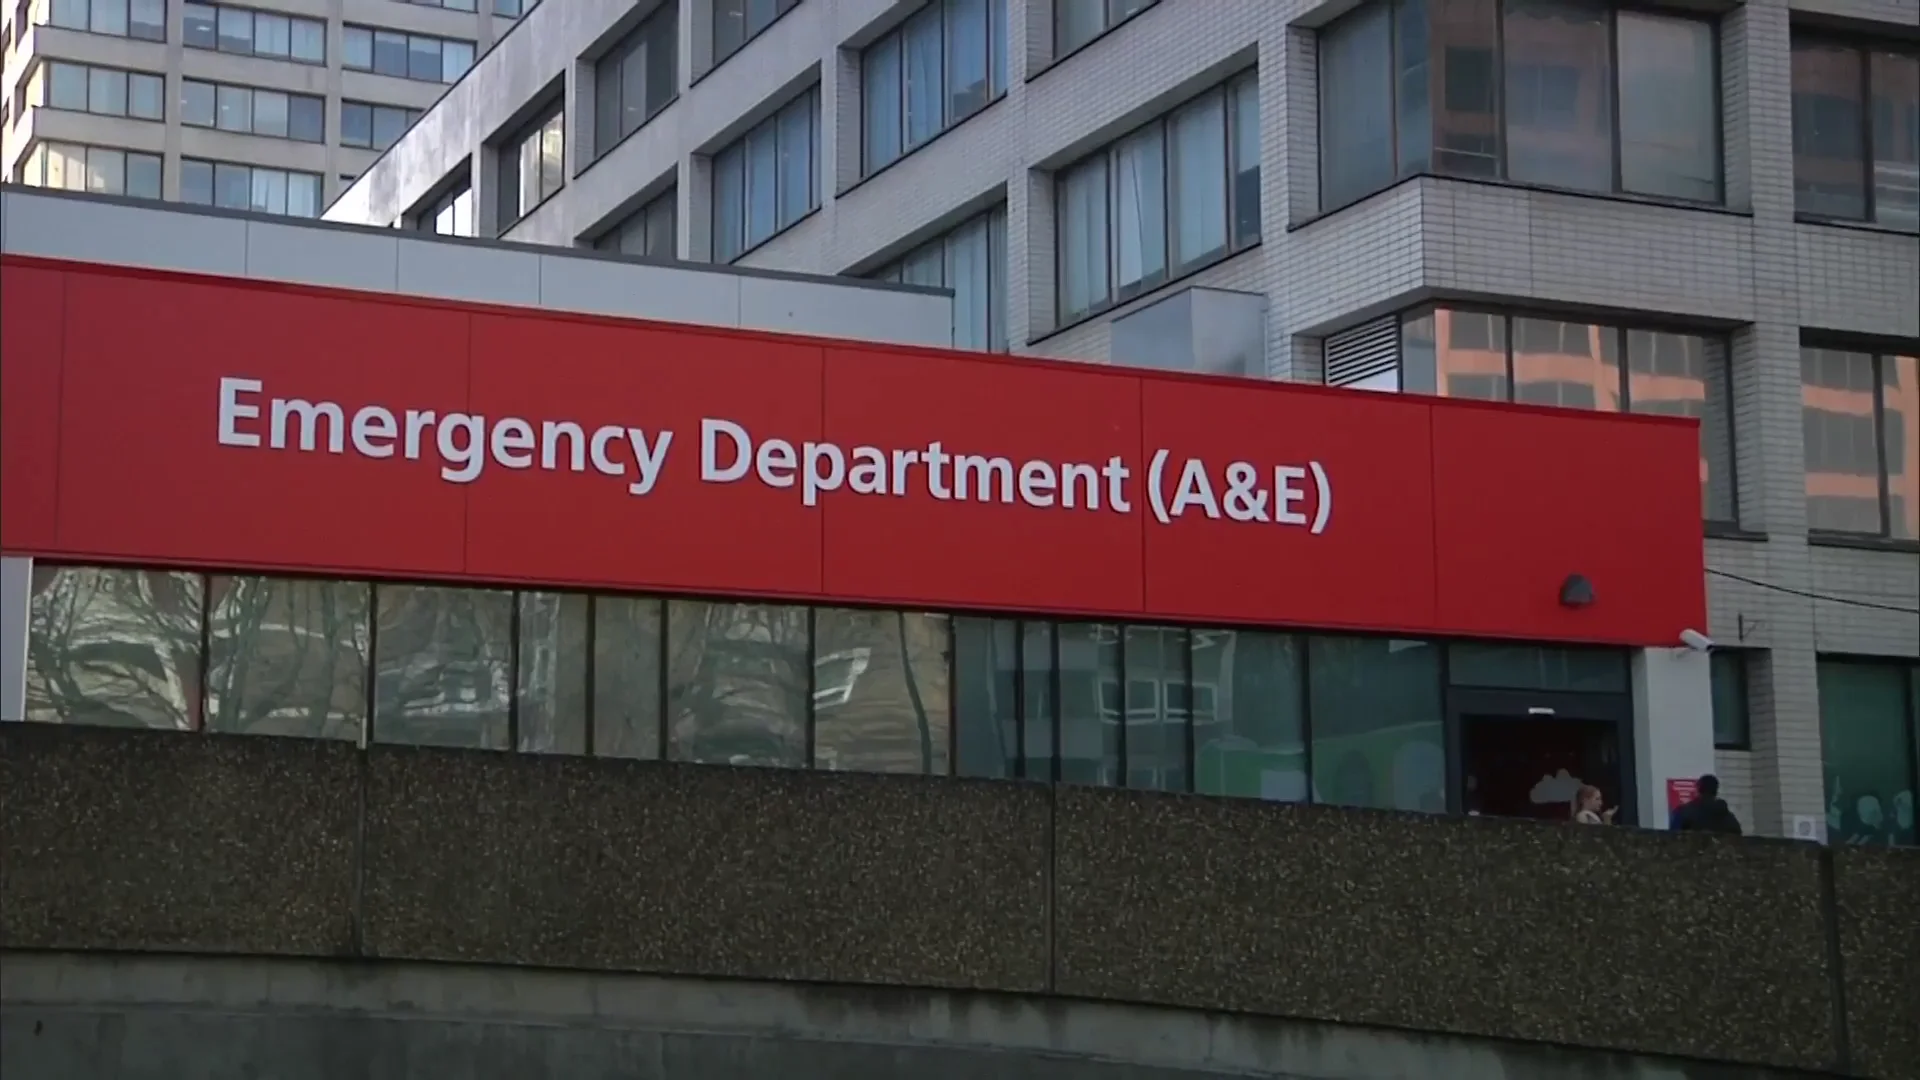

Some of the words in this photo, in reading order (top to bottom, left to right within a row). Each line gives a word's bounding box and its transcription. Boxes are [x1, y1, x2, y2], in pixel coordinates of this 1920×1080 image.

[217, 376, 674, 496] Emergency
[700, 417, 1131, 513] Department
[1147, 448, 1331, 535] (A&E)
